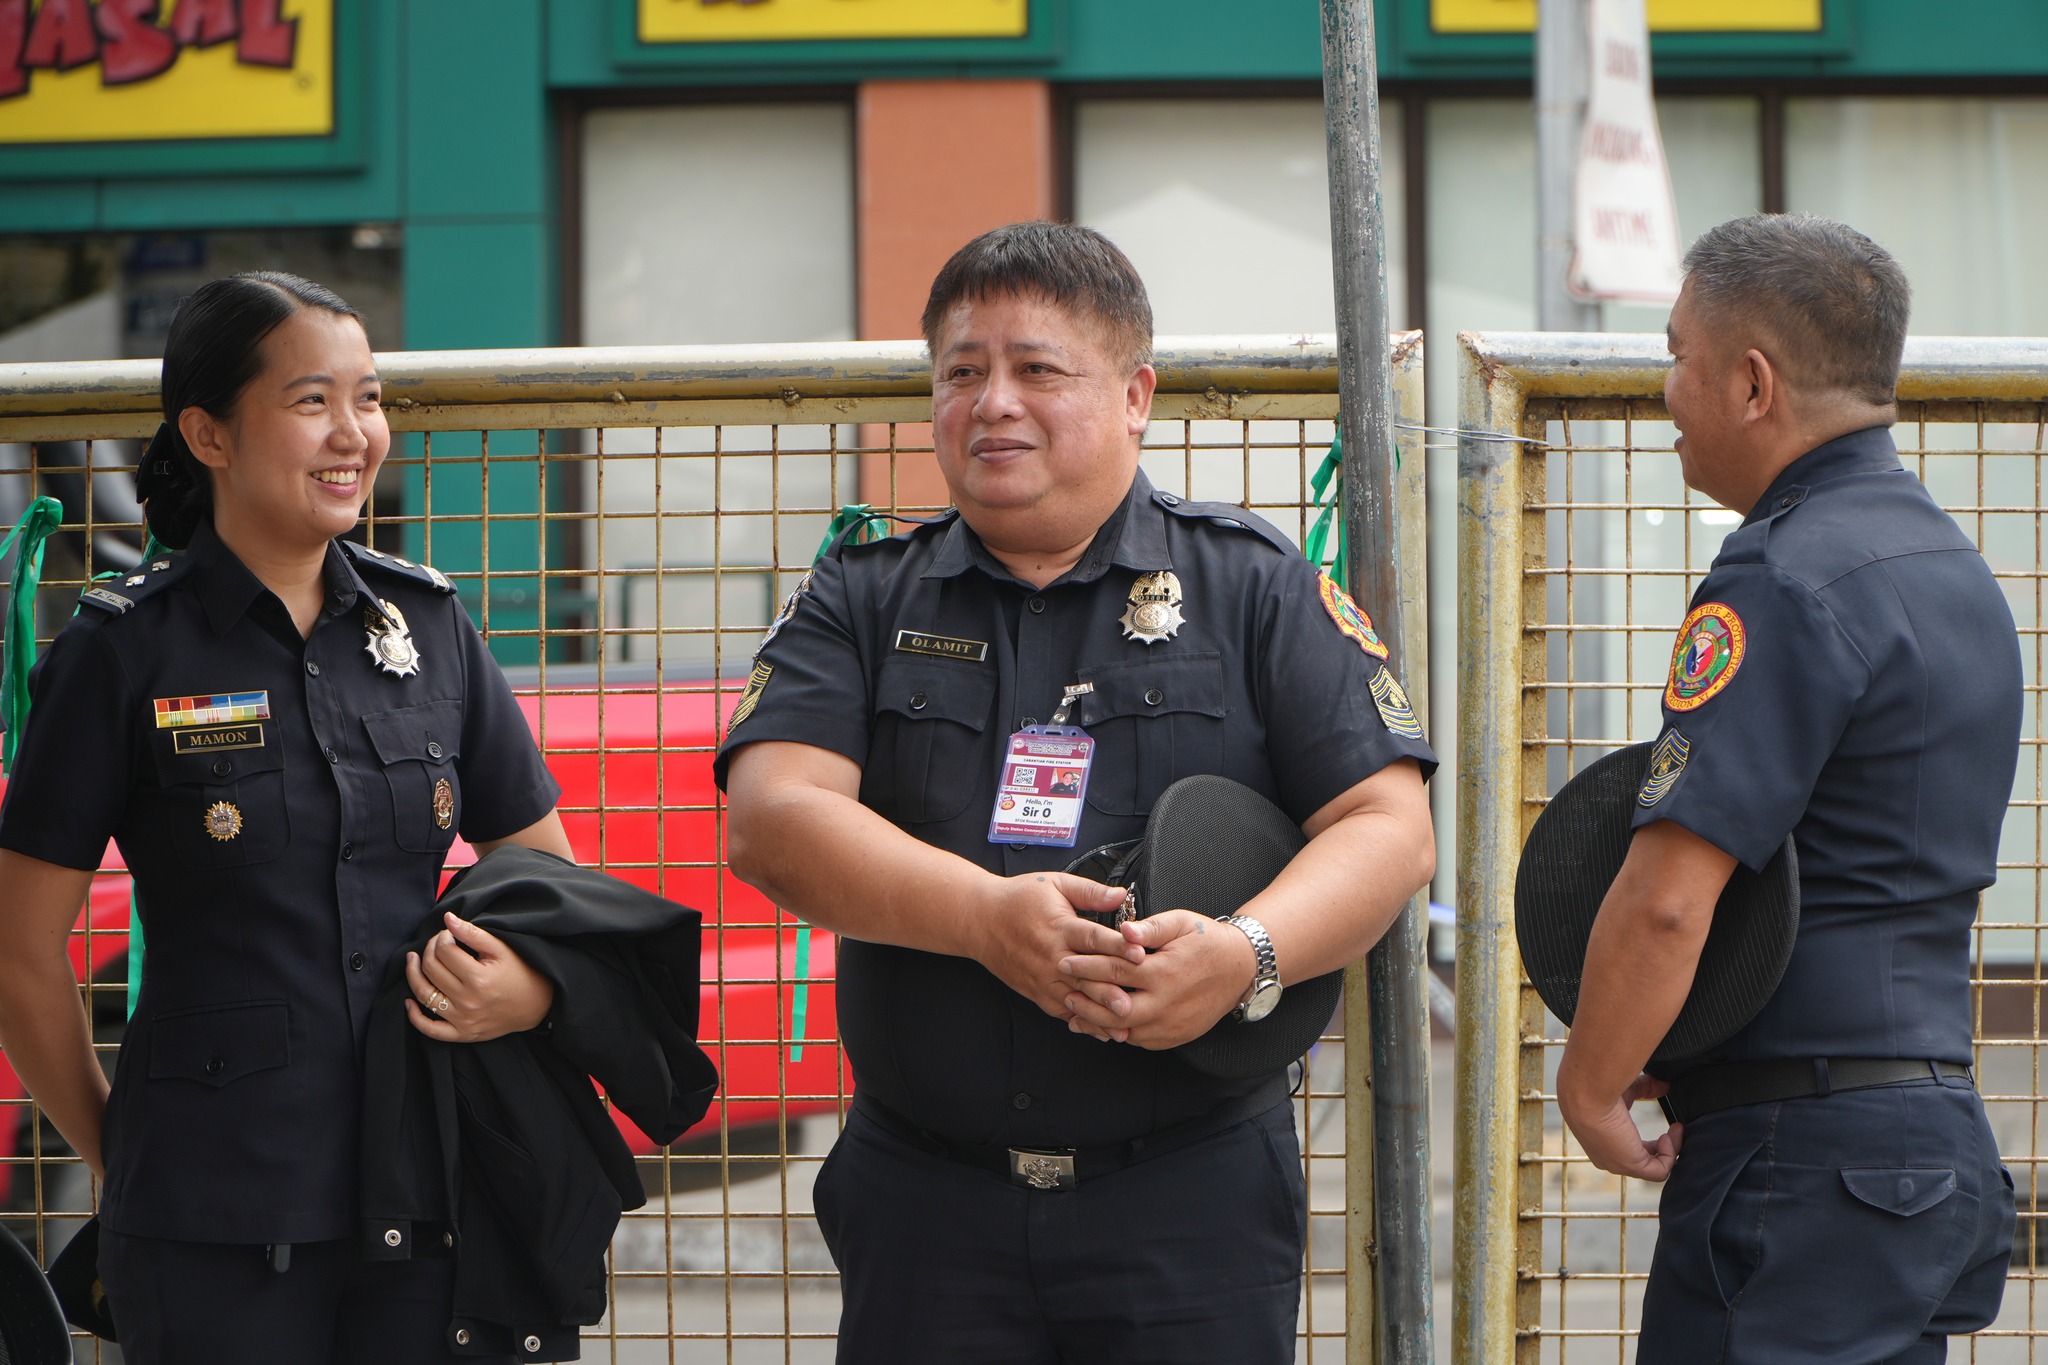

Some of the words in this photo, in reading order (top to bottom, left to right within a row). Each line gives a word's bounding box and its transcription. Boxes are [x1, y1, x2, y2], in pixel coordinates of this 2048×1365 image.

[912, 637, 971, 653] OLAMIT
[1699, 605, 1723, 616] FIRE
[1721, 612, 1744, 684] PROTECTION
[190, 731, 247, 745] MAMON
[1025, 798, 1043, 806] Hello,
[1022, 806, 1039, 817] Sir
[1042, 808, 1051, 818] O
